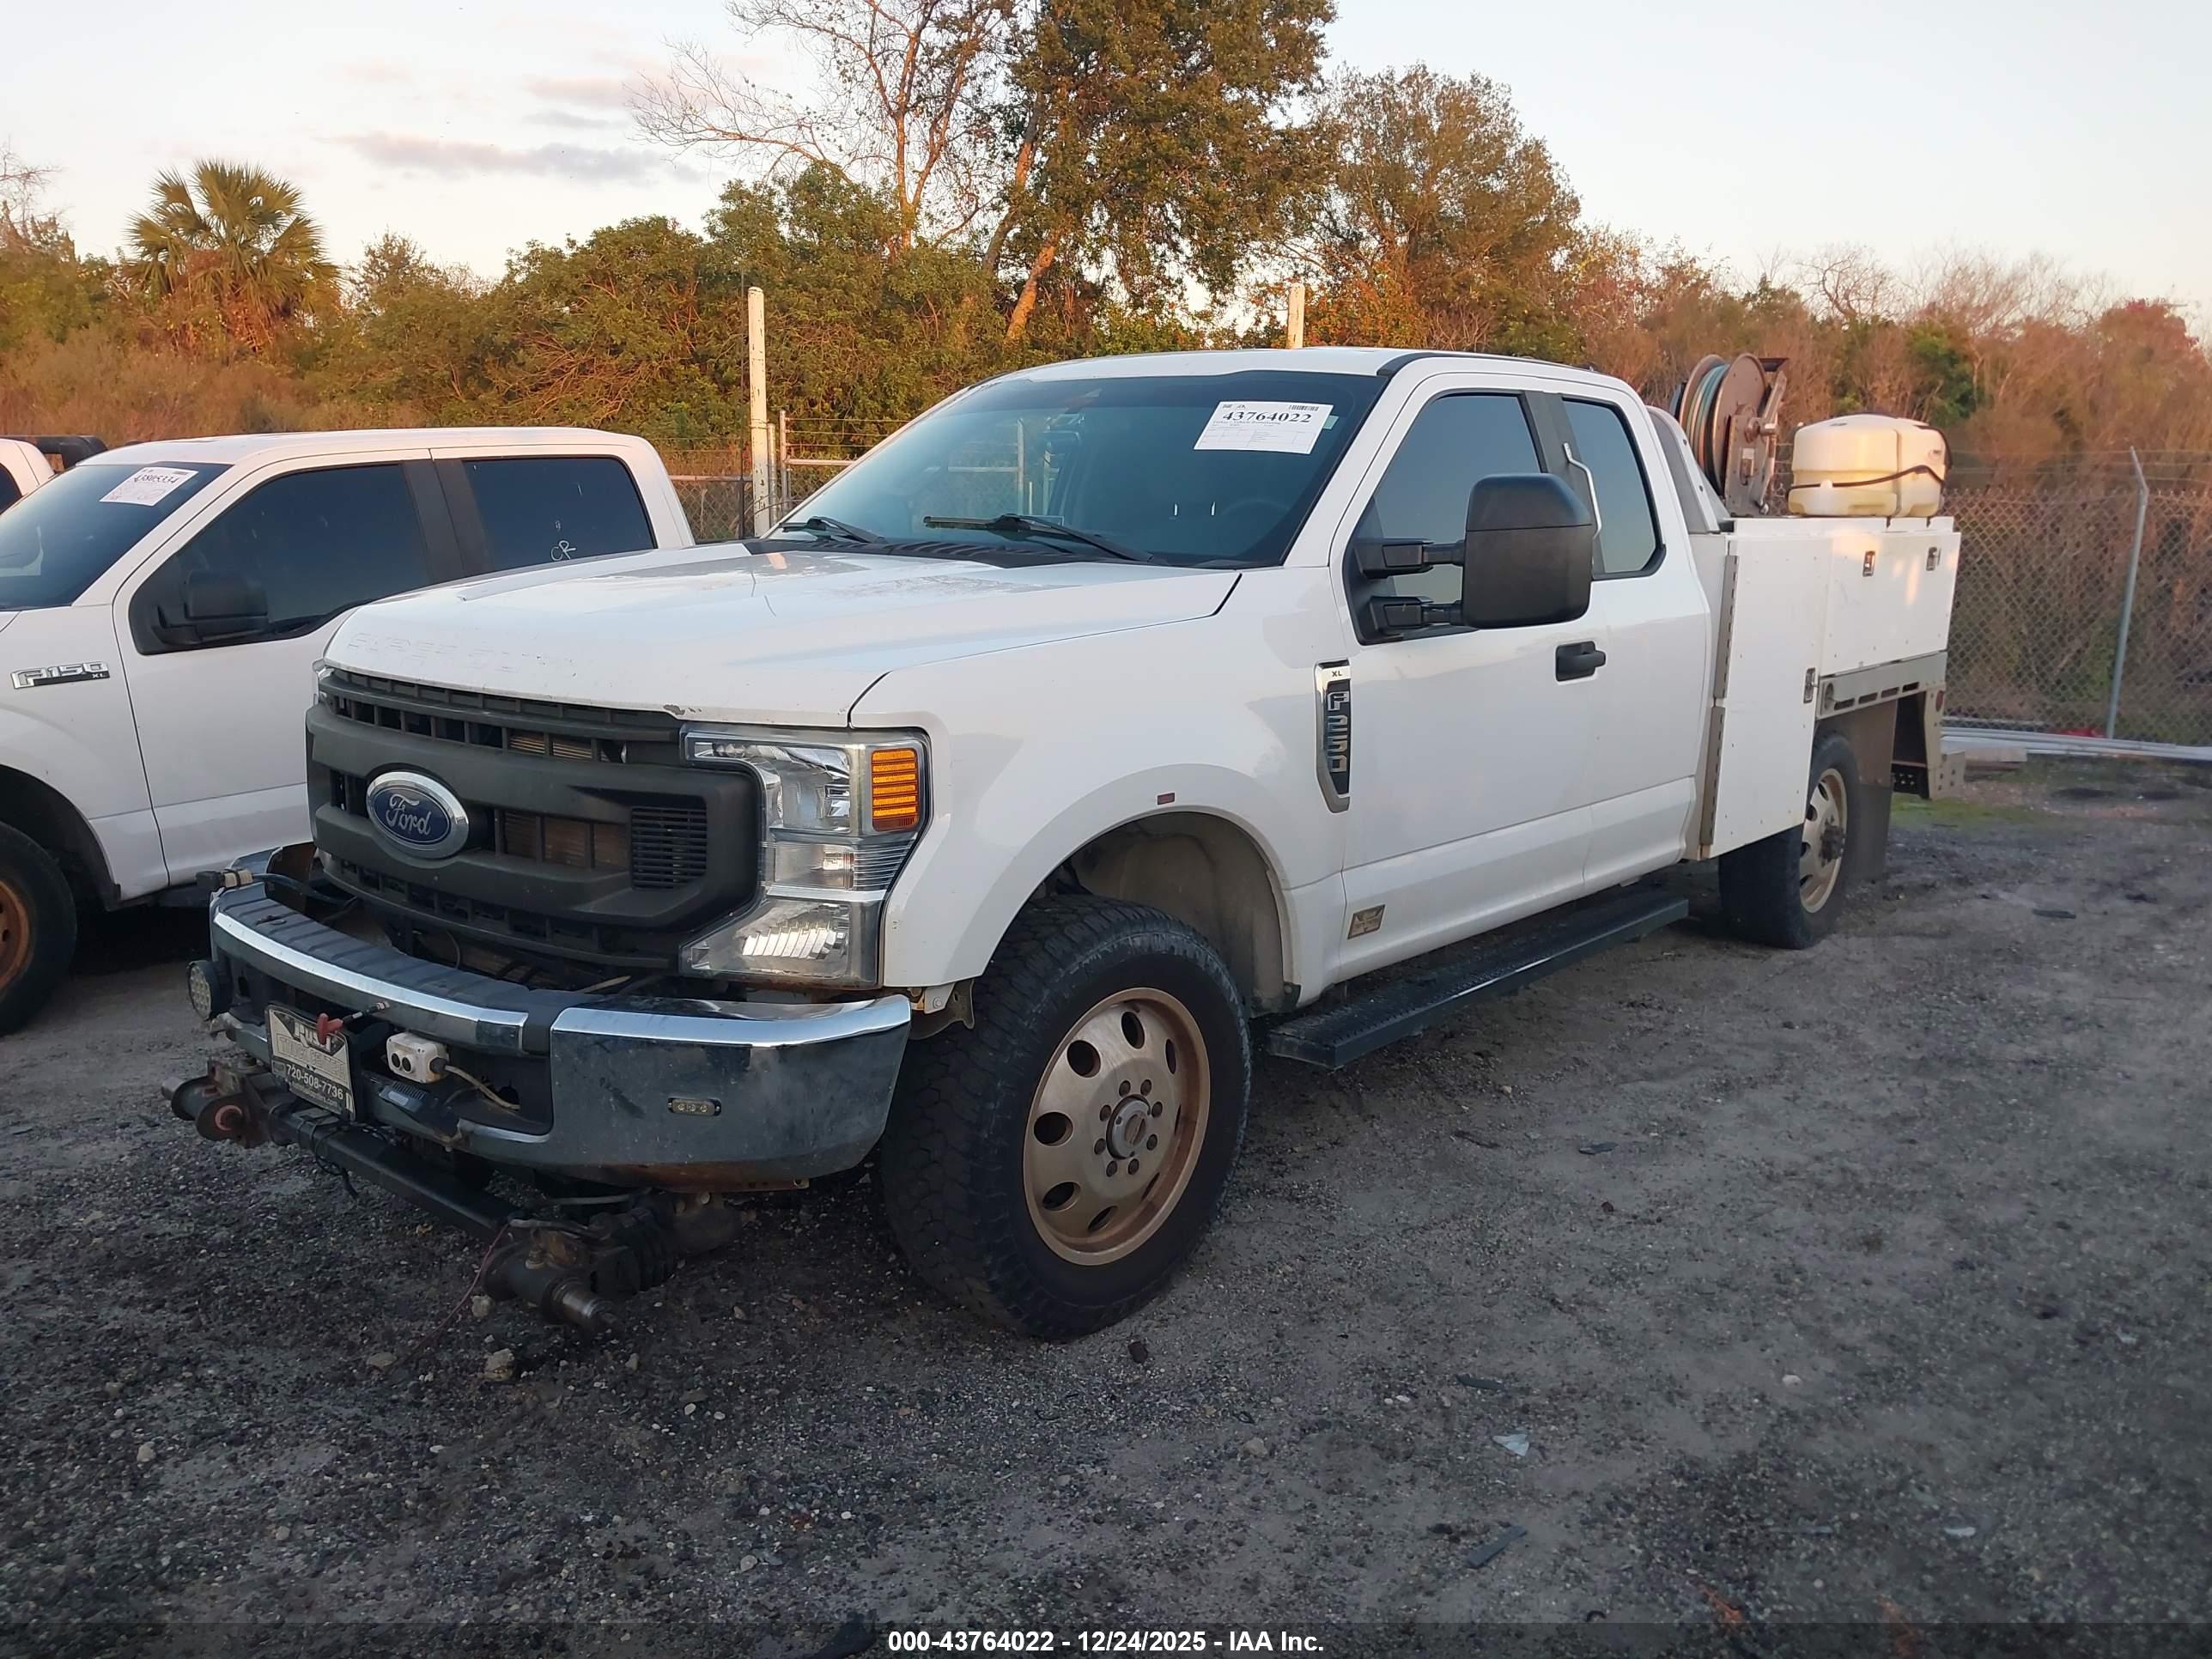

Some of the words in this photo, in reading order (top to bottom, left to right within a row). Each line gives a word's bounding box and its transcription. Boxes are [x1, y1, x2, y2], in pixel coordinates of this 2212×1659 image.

[1222, 411, 1312, 423] 43764022
[10, 661, 108, 690] F150
[1327, 691, 1350, 773] F250
[386, 793, 432, 836] Ford
[286, 1064, 343, 1100] 720-508-7736
